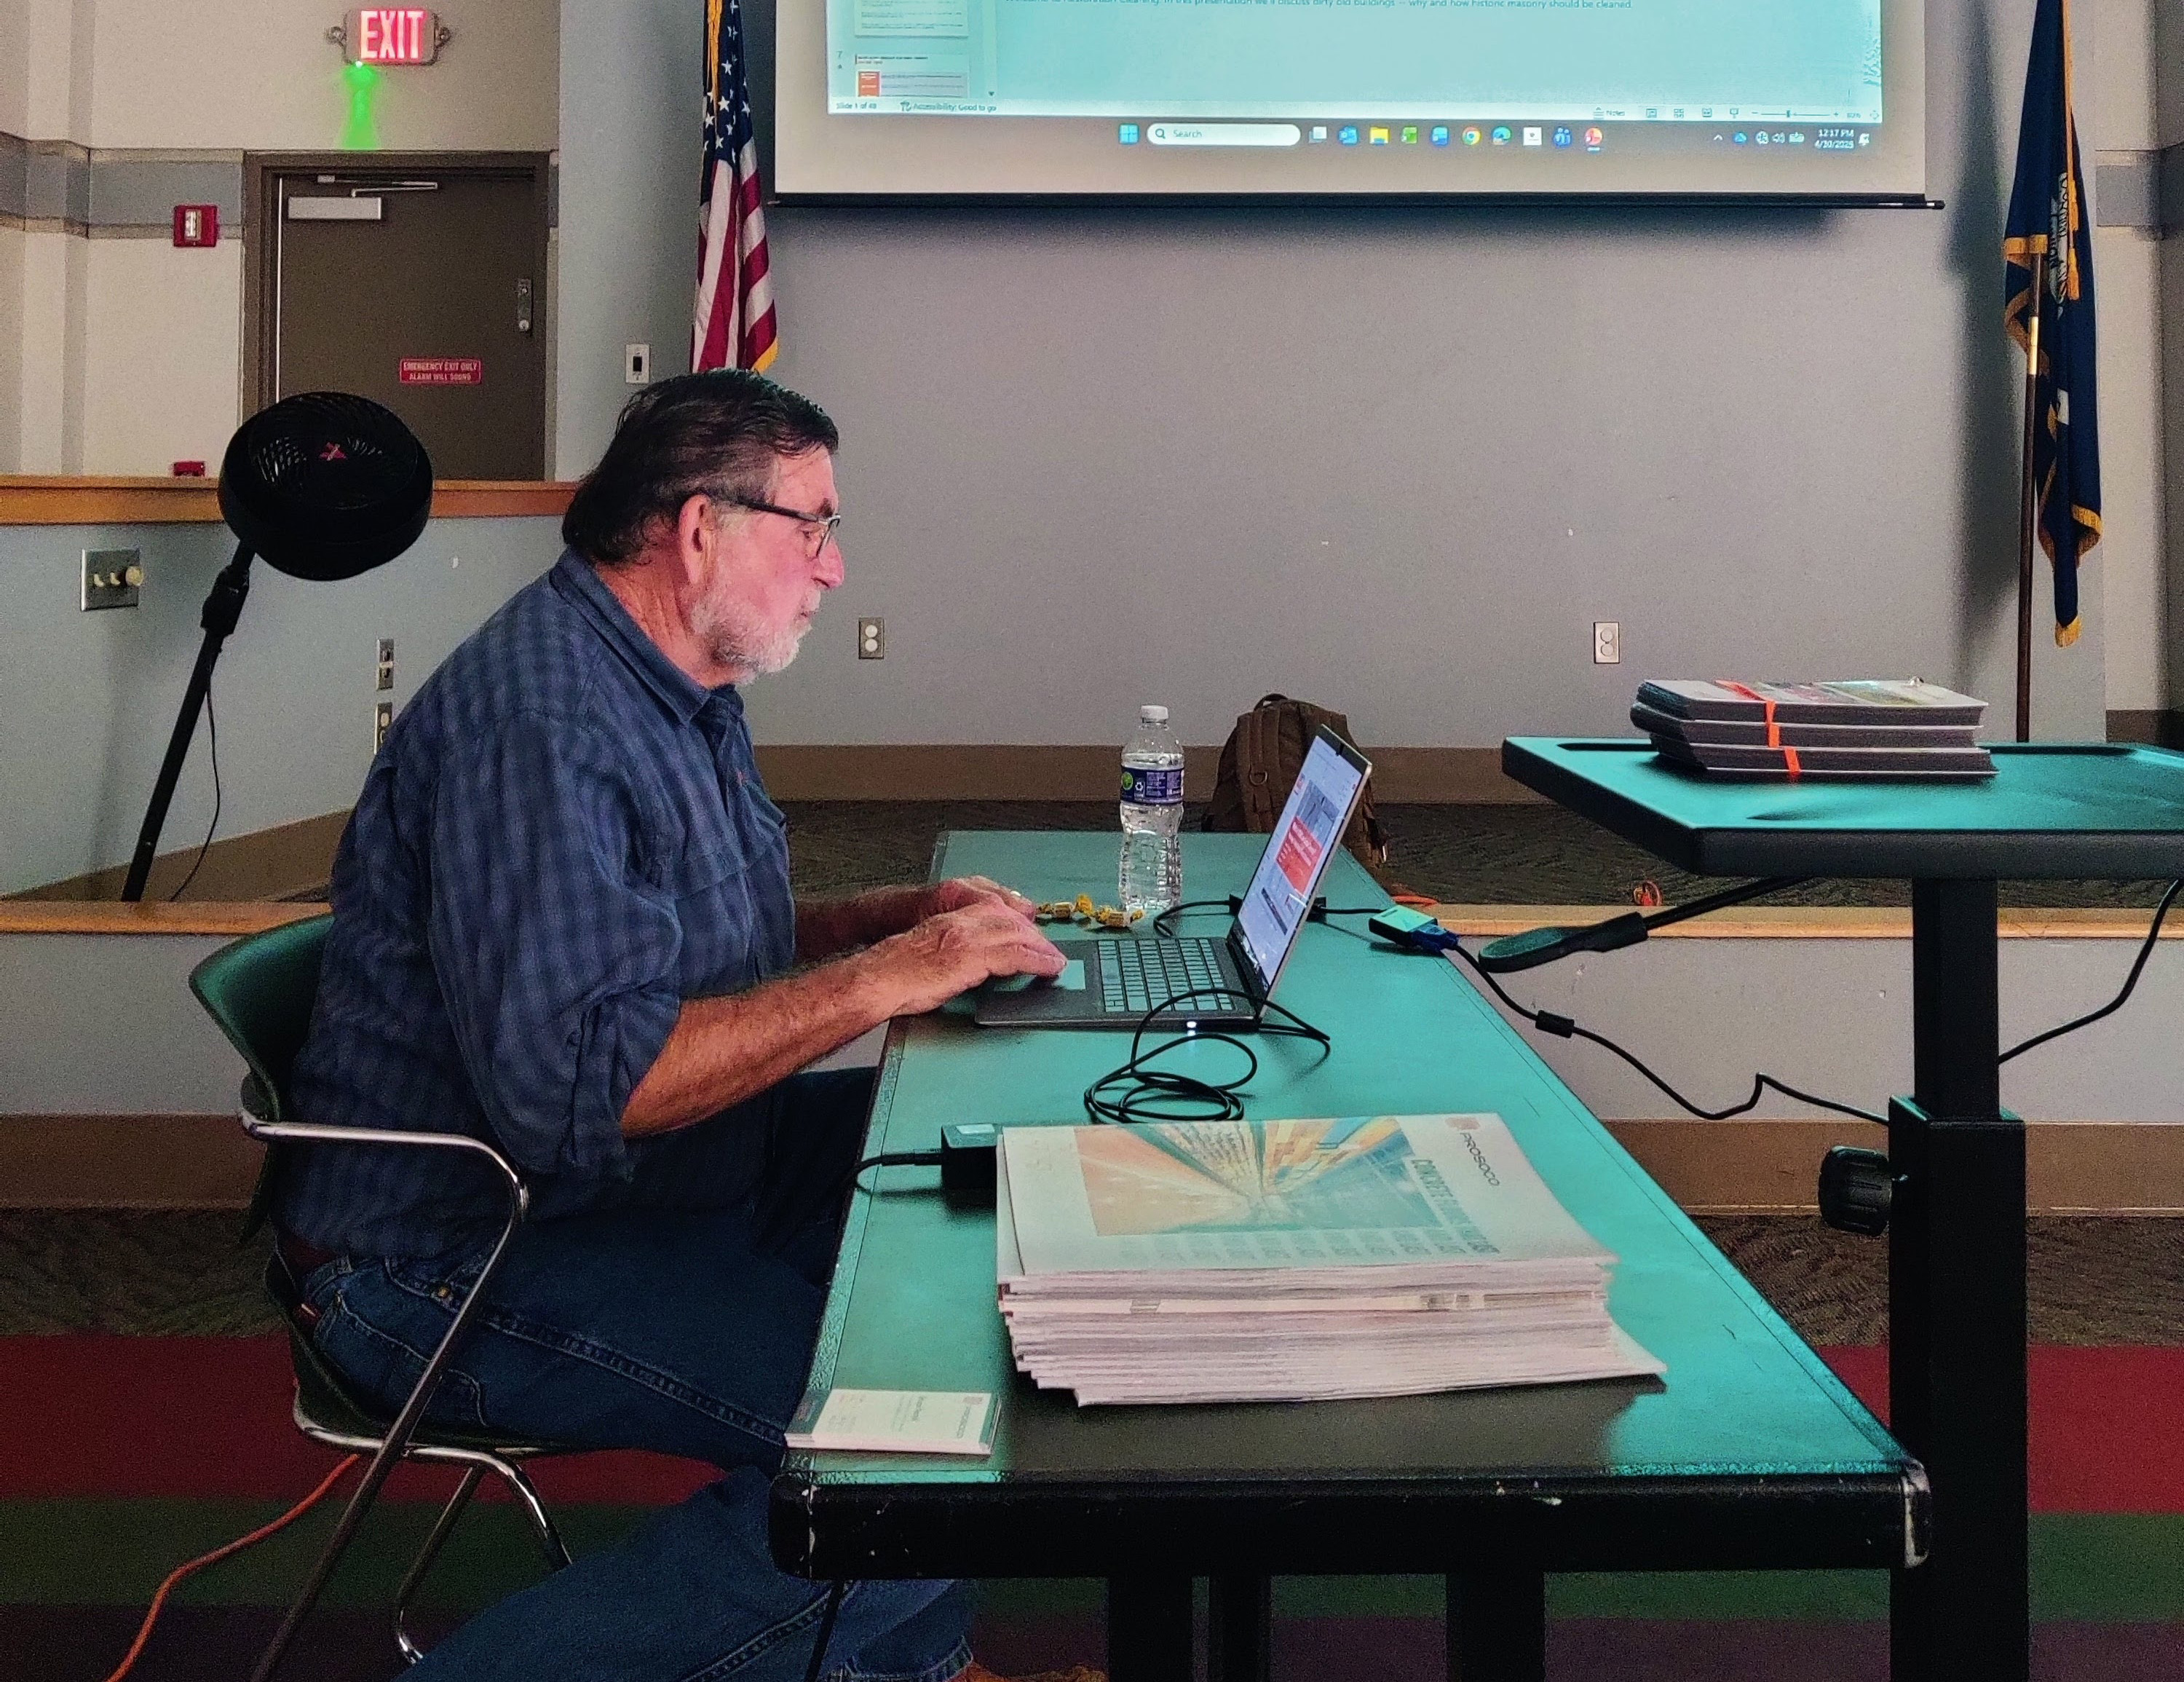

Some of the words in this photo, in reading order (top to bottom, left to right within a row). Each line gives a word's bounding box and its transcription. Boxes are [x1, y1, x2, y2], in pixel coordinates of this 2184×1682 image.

[1582, 0, 1594, 8] be
[360, 10, 424, 59] EXIT
[1173, 128, 1202, 138] Search
[1840, 129, 1854, 138] PM
[444, 361, 459, 372] EXIT
[460, 362, 478, 372] ONLY
[1460, 1132, 1500, 1187] PROSOCO
